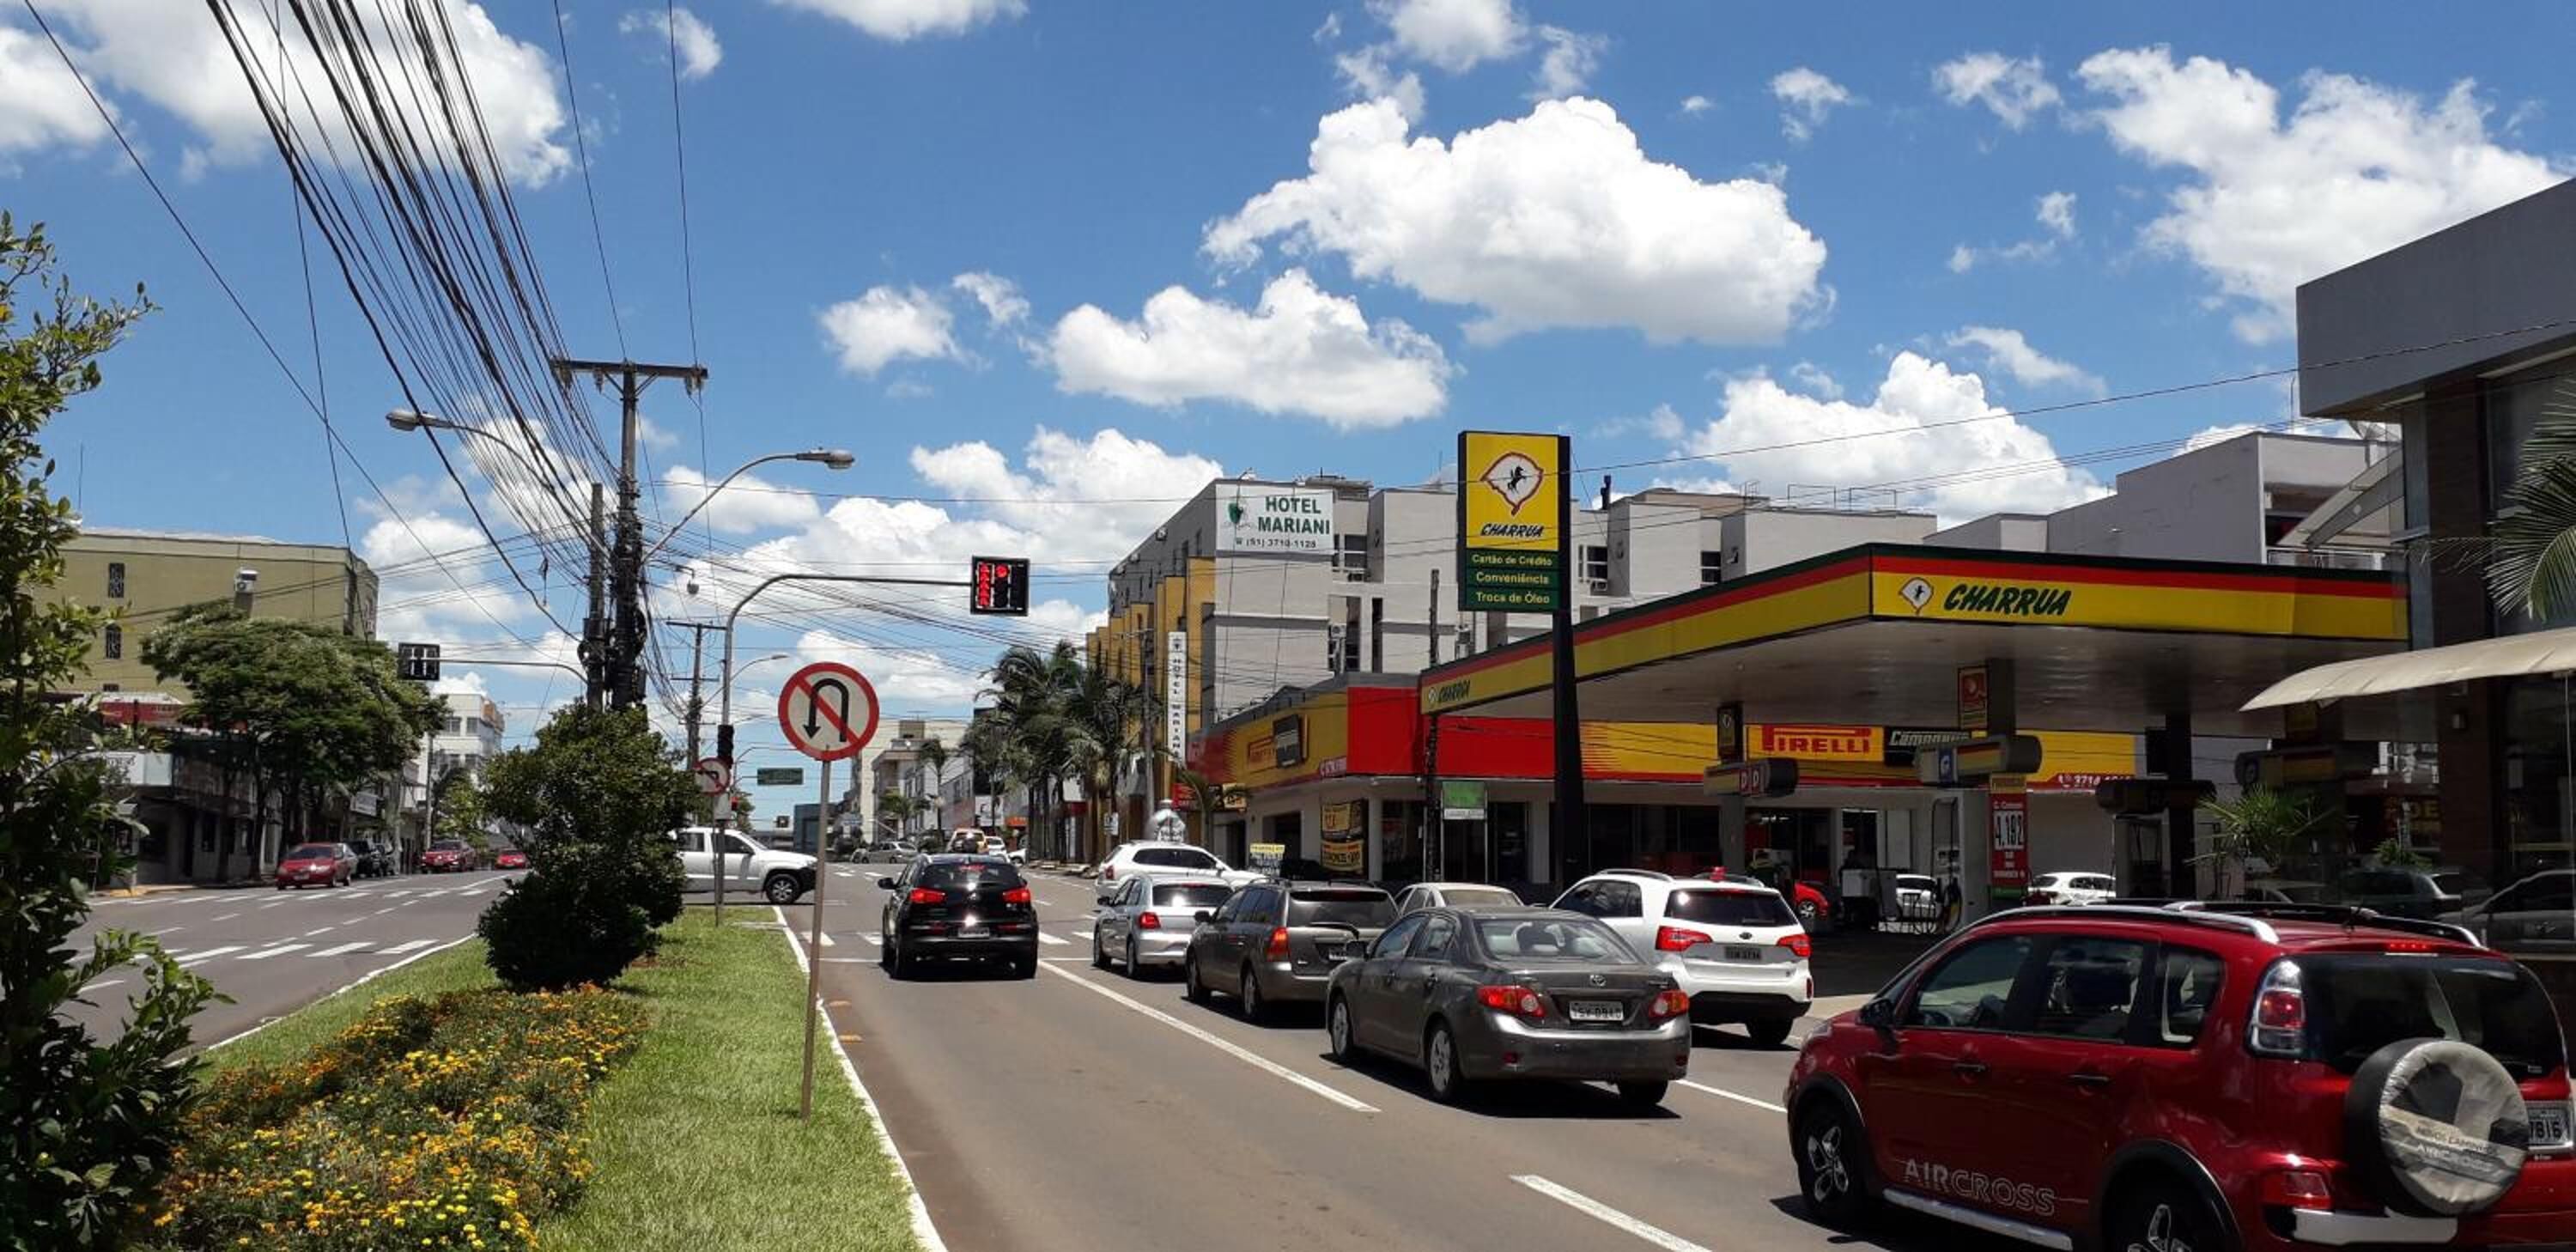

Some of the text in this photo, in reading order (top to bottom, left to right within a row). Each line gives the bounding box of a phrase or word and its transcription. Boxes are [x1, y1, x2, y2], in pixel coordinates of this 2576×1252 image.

[1265, 495, 1321, 514] HOTEL
[1258, 517, 1330, 534] MARIANI
[1480, 523, 1545, 538] CHARRUA
[1505, 556, 1516, 564] de
[1476, 571, 1549, 584] Conveniência
[1476, 590, 1550, 604] Troca de Óleo
[1943, 583, 2072, 616] CHARRUA
[1761, 725, 1873, 753] PIRELLI
[1904, 1158, 2055, 1217] AIRCROSS
